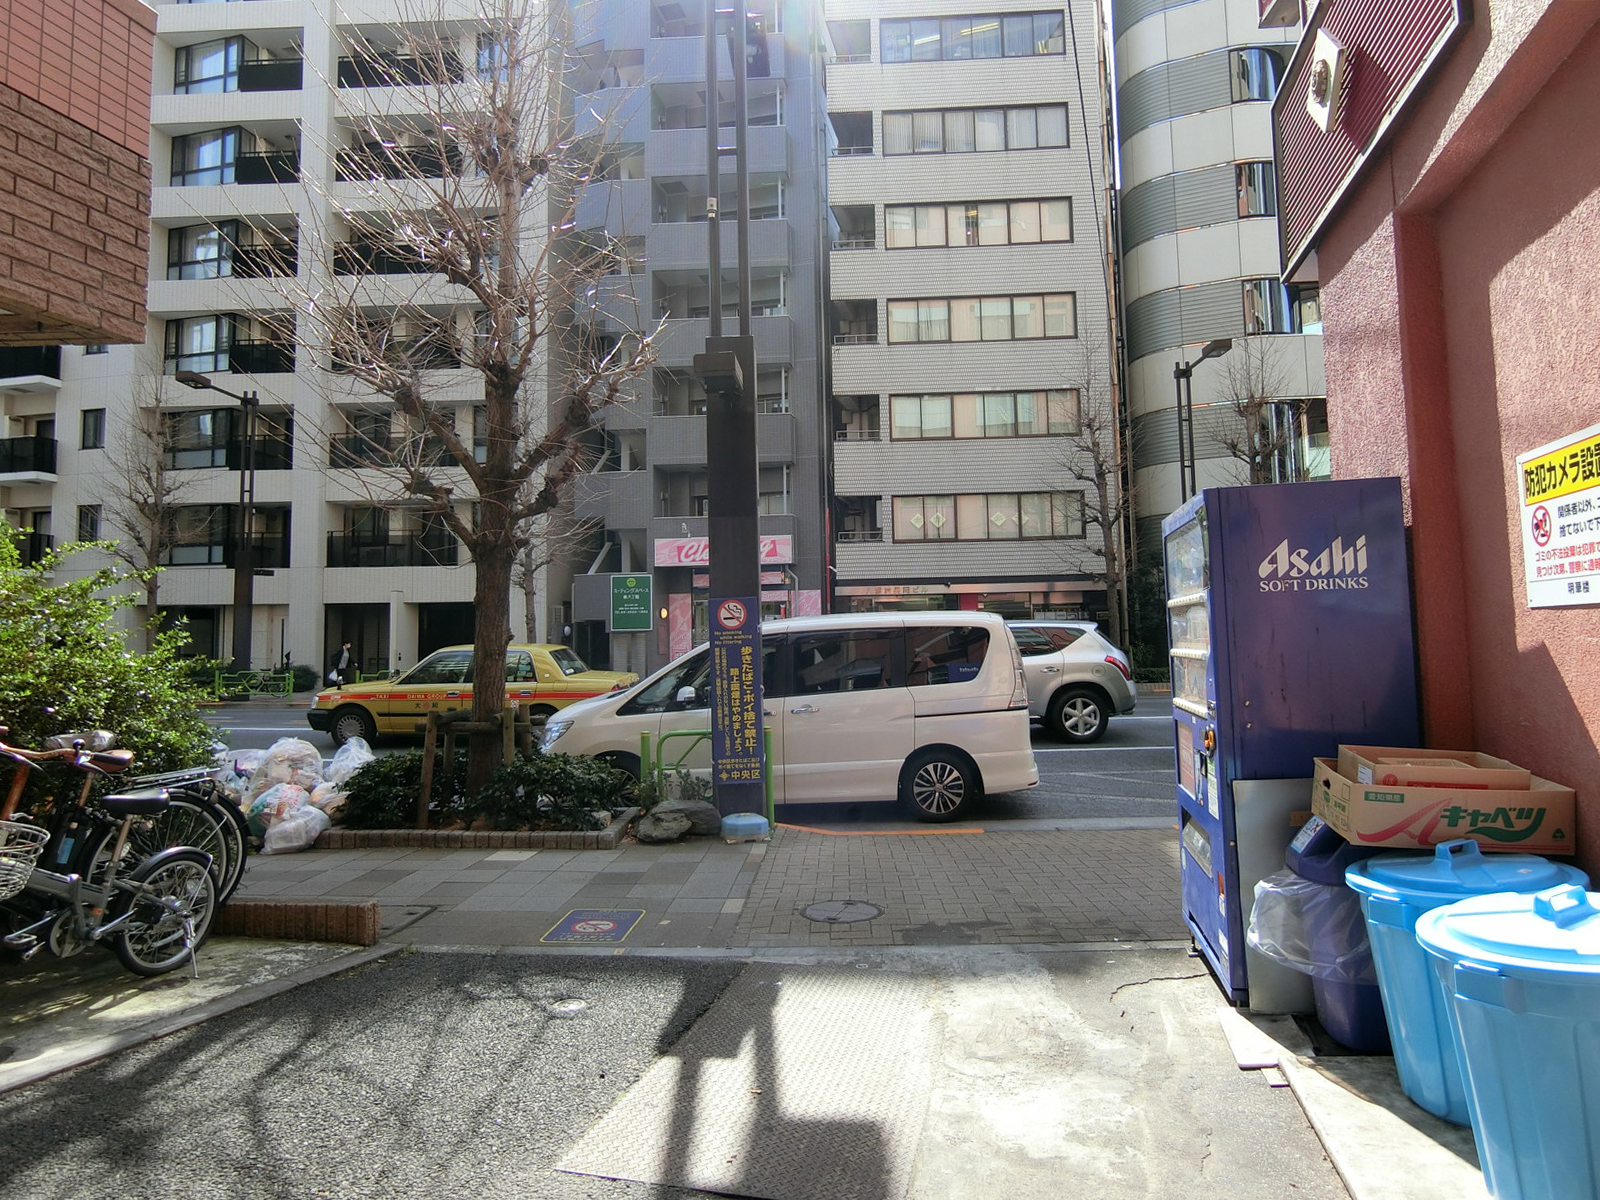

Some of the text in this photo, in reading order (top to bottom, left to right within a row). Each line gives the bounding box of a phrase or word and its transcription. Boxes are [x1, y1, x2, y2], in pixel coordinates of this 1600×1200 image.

[1258, 534, 1368, 579] Asahi
[1259, 576, 1369, 593] SOFT DRINKS
[731, 769, 761, 780] 中央区
[1368, 792, 1402, 802] 愛知県産
[1440, 806, 1547, 843] キャベツ
